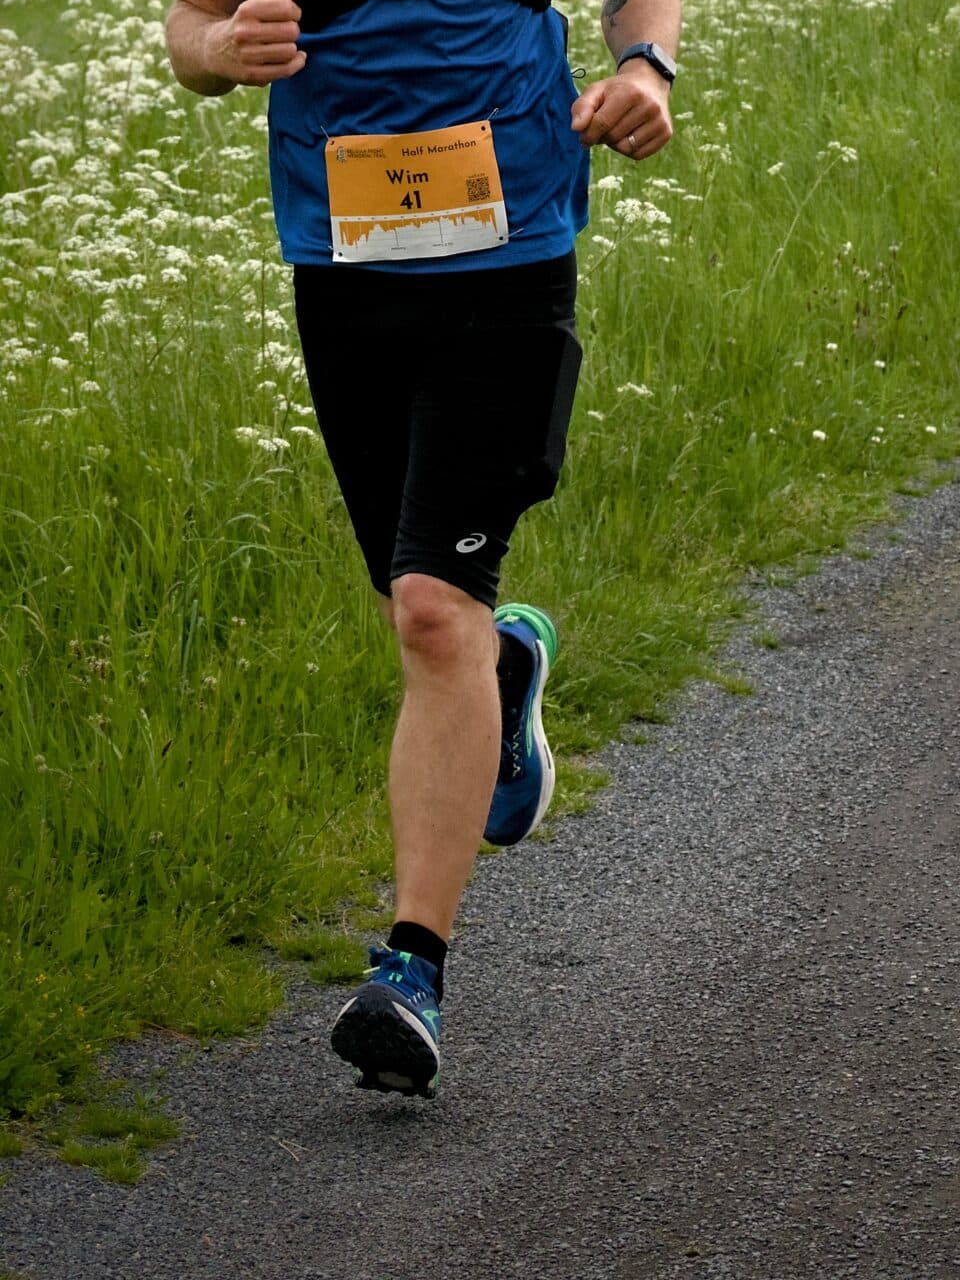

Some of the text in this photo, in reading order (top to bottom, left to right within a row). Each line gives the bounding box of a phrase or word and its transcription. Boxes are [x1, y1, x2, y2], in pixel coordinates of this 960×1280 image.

[402, 147, 424, 157] Half
[428, 139, 477, 154] Marathon
[386, 169, 429, 185] Wim
[400, 190, 423, 210] 41
